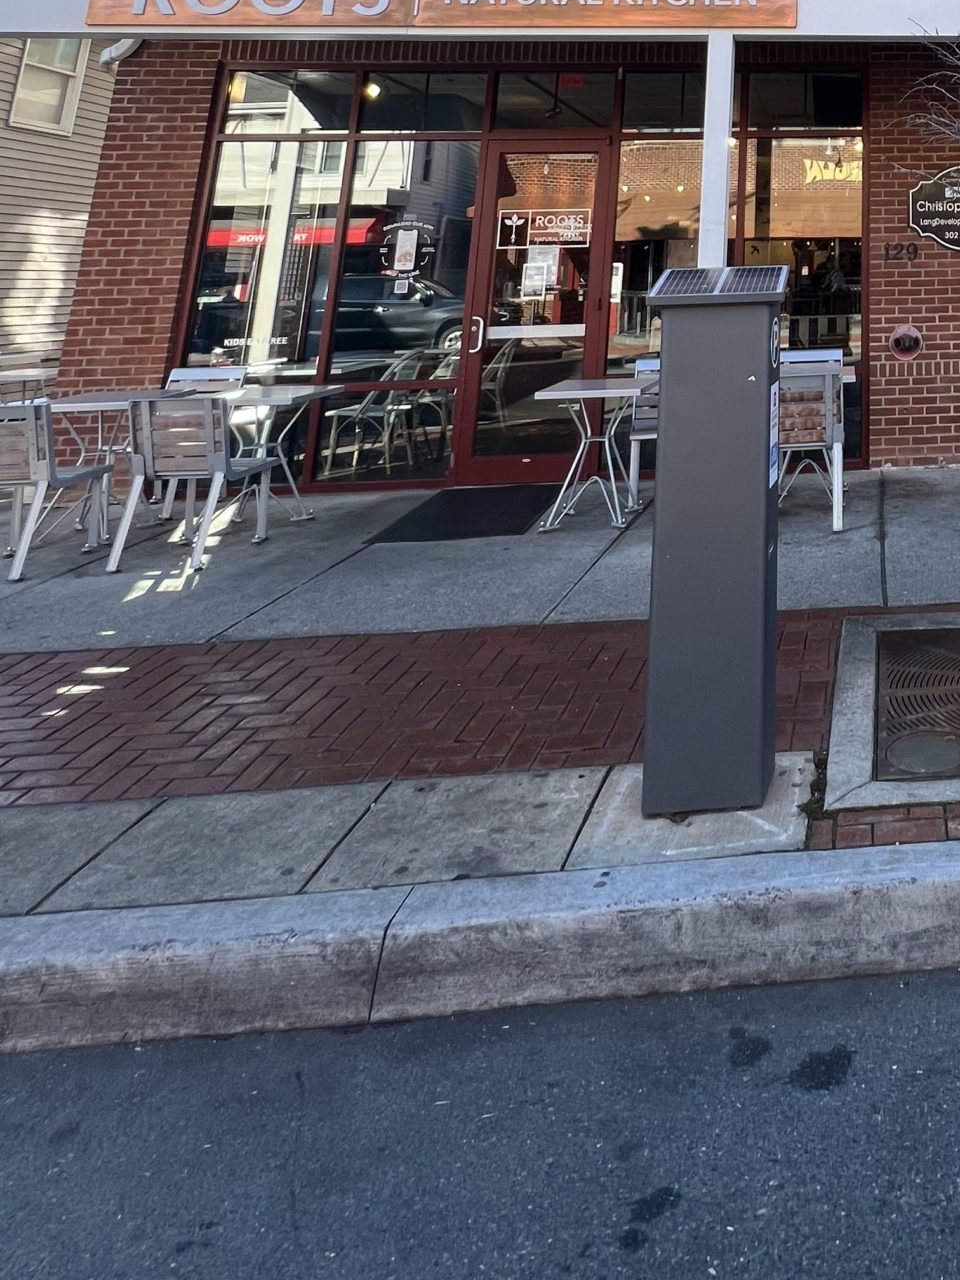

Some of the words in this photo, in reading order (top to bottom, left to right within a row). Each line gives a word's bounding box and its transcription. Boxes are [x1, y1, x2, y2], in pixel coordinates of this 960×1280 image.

[535, 214, 584, 227] ROOTS
[944, 231, 959, 239] 302
[884, 242, 919, 262] 129
[223, 337, 246, 347] KIDS
[269, 336, 289, 345] REE
